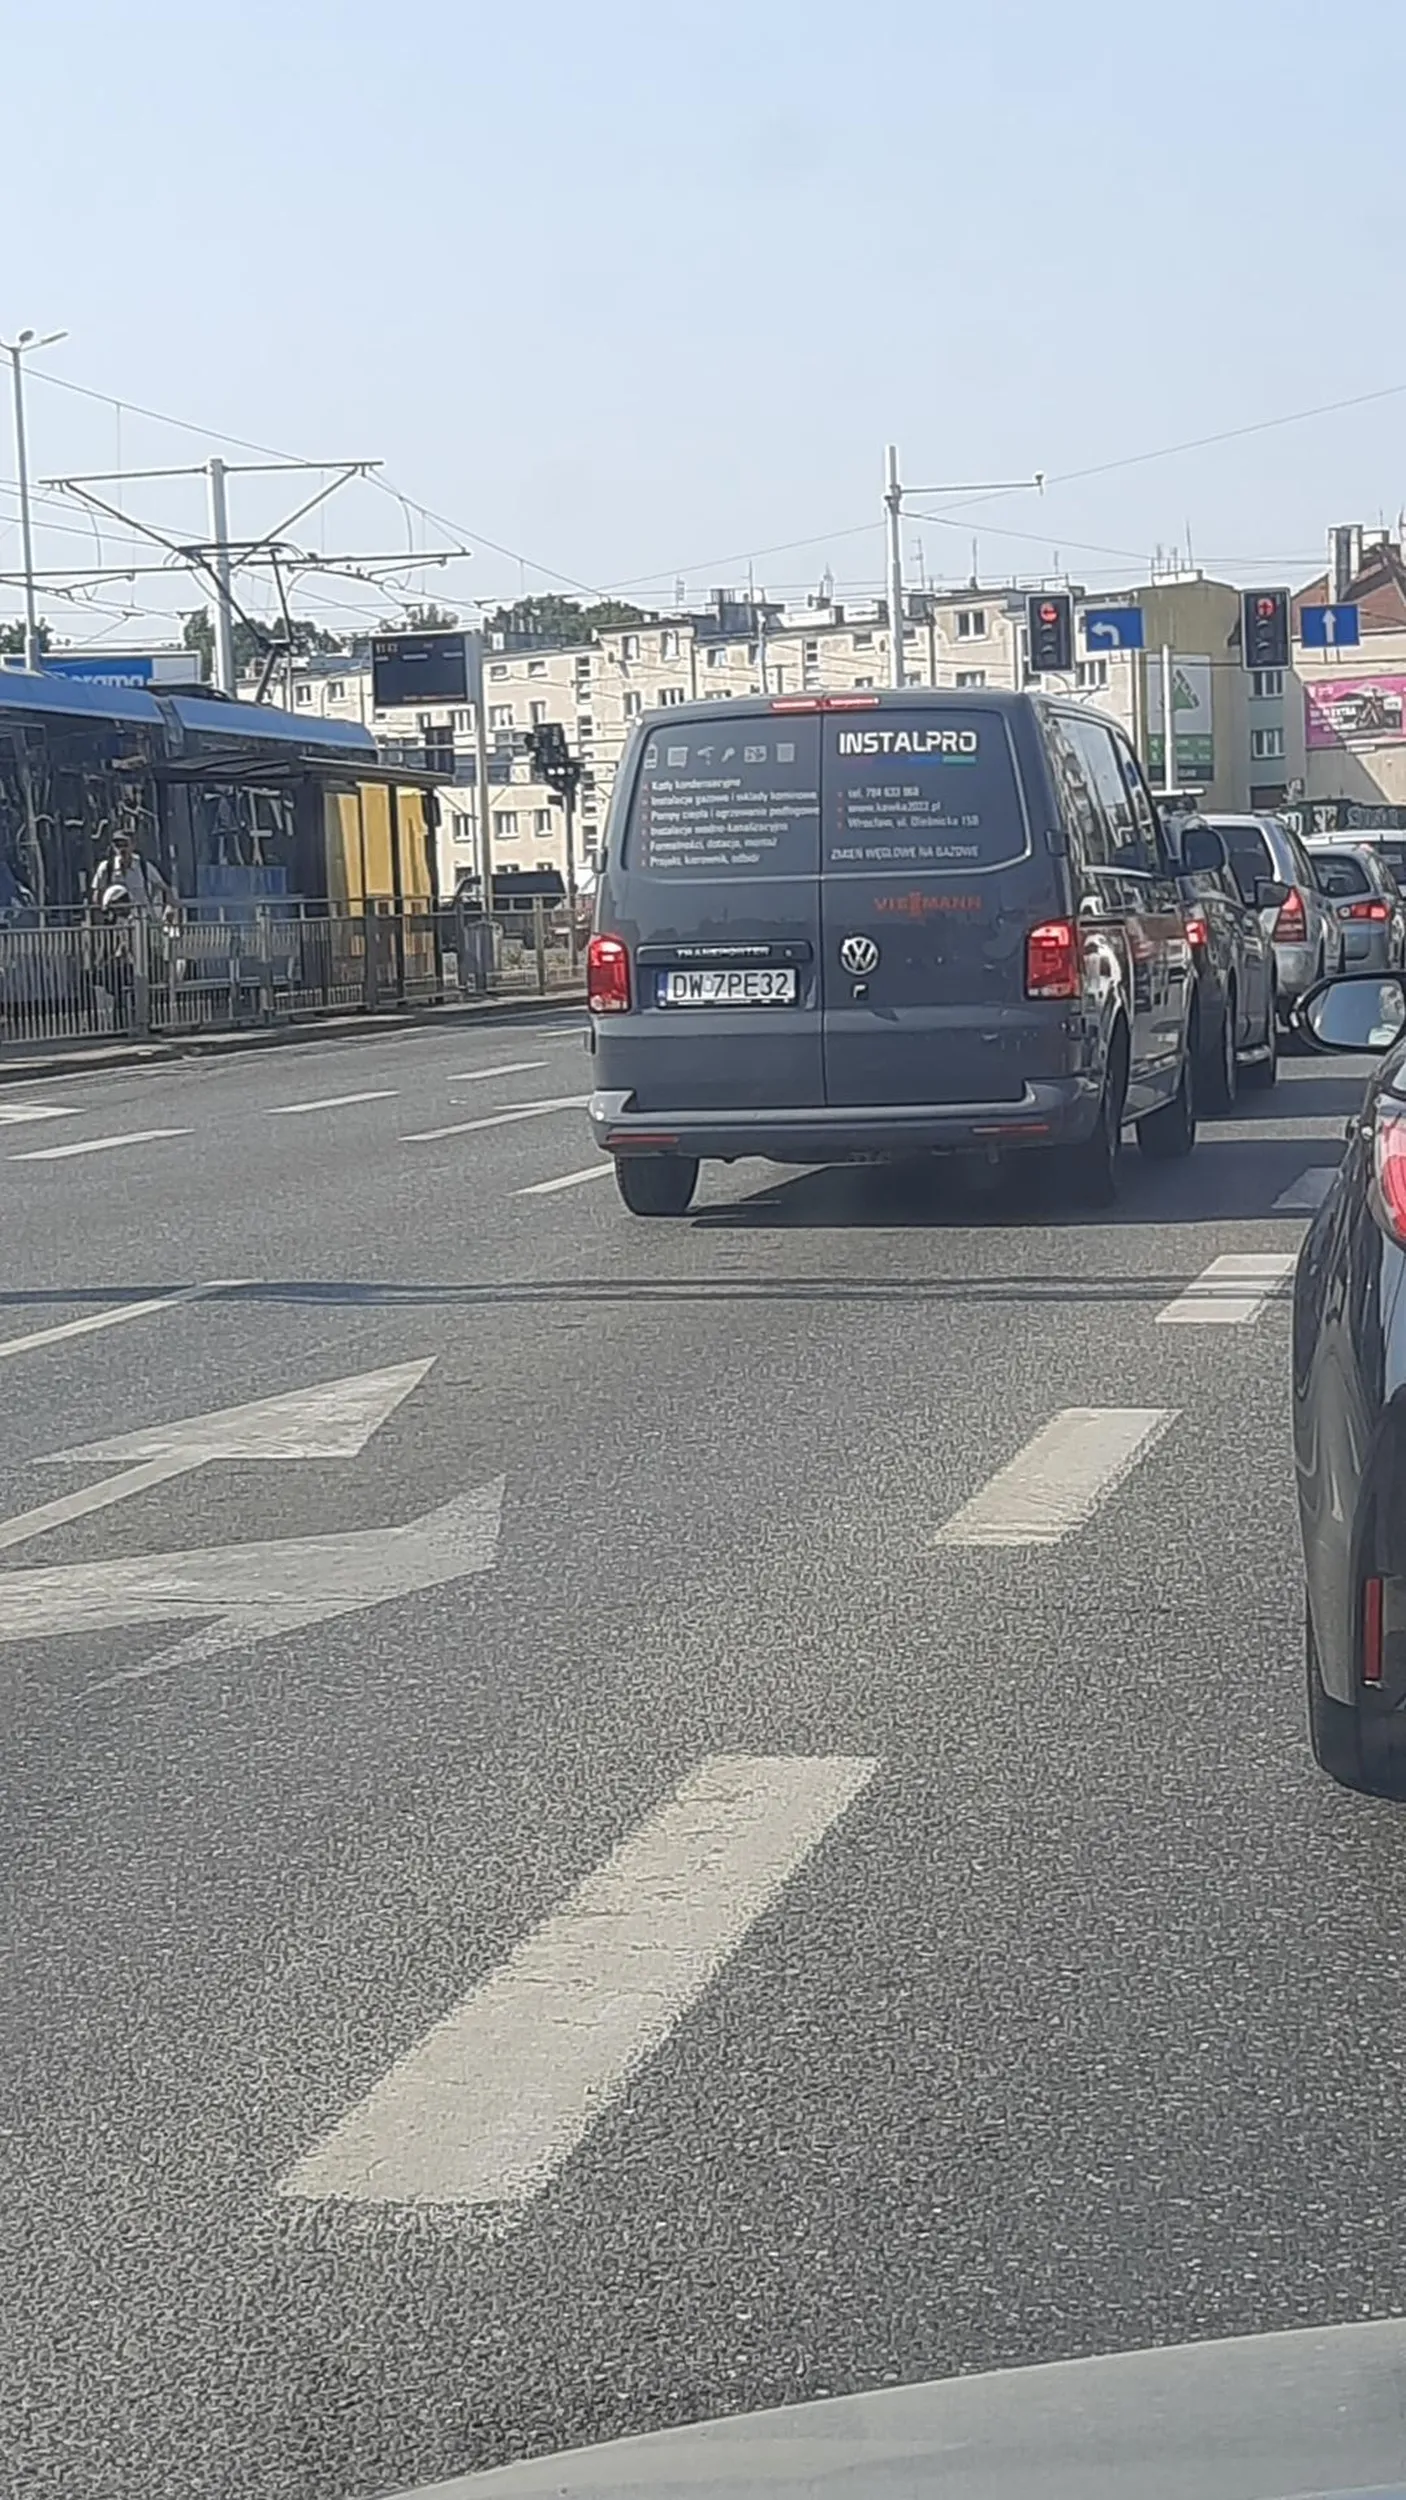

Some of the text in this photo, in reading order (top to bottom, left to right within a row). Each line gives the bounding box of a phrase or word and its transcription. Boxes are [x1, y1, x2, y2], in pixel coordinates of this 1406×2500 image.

[839, 731, 977, 753] INSTALPRO
[650, 794, 693, 806] Instalacje
[695, 794, 729, 806] gazowe
[770, 790, 818, 801] kominowe
[650, 810, 680, 822] Pompy
[716, 809, 767, 820] ogrzewanie
[650, 824, 693, 836] Instalacje
[917, 845, 935, 858] NA
[672, 970, 789, 998] DW 7PE32
